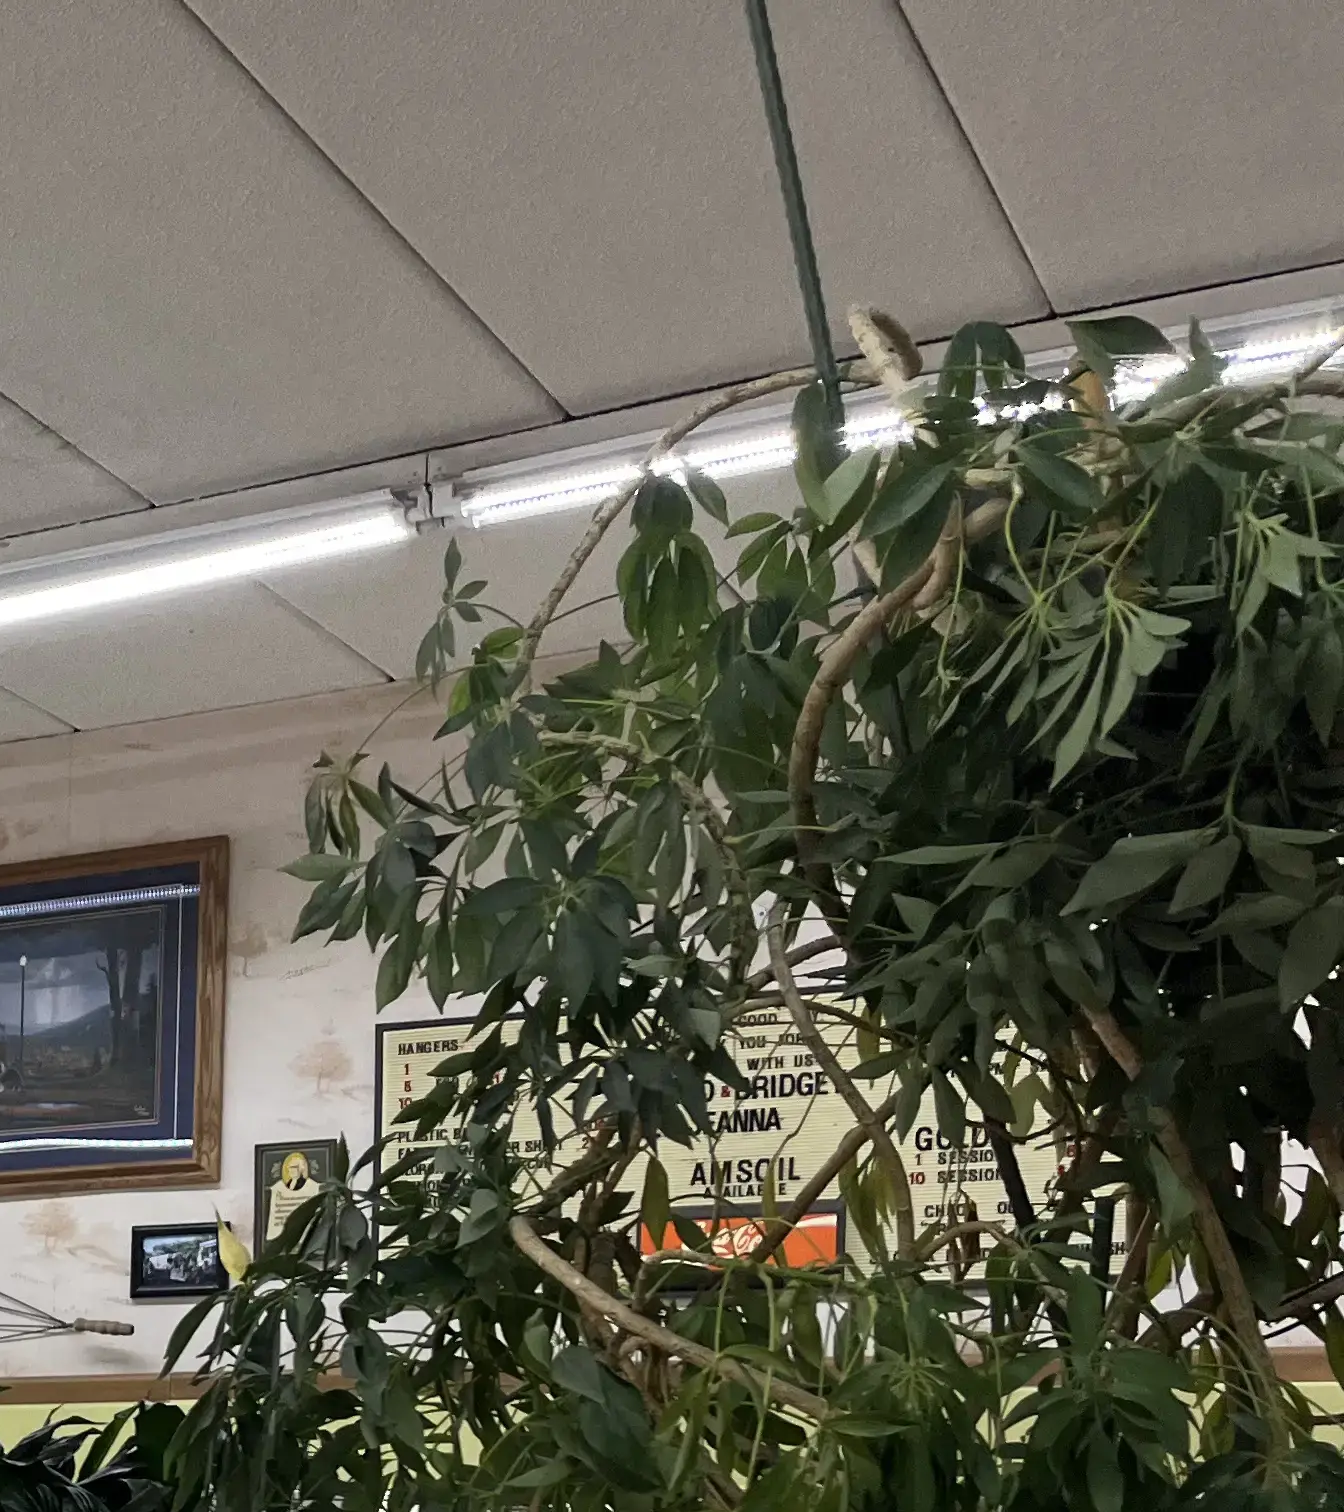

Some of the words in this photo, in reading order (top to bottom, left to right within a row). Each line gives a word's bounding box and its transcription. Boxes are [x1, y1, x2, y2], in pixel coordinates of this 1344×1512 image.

[739, 1012, 778, 1025] GOOD
[398, 1039, 459, 1055] HANGERS
[740, 1034, 766, 1049] YOU
[746, 1054, 784, 1071] WITH
[721, 1085, 731, 1097] &
[691, 1157, 801, 1186] AMSOIL
[909, 1172, 926, 1185] 10
